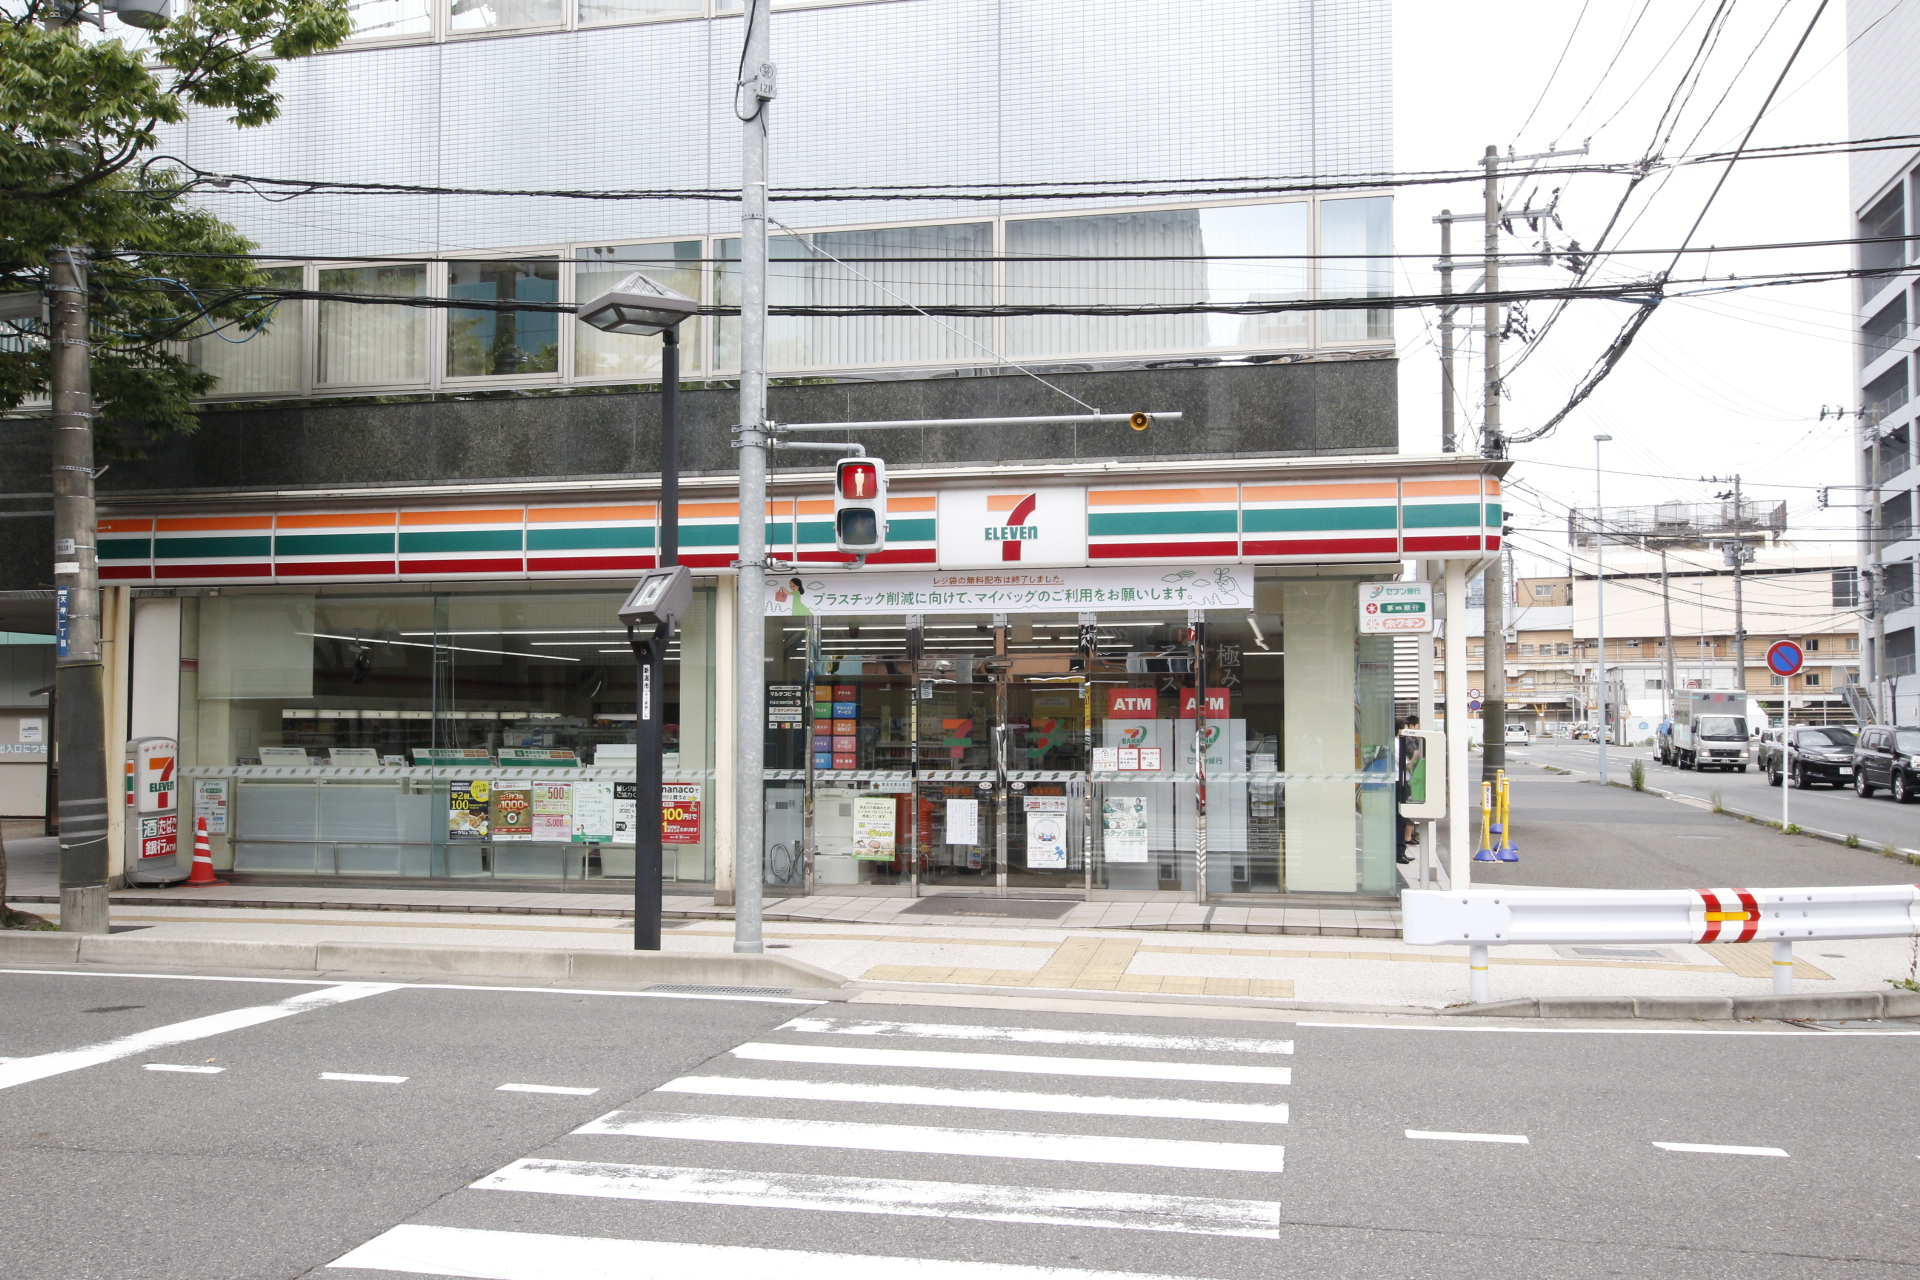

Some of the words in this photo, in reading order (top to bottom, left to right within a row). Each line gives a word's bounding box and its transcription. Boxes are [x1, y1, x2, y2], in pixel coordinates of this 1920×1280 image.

[987, 493, 1036, 561] 7
[933, 575, 1065, 585] レジ袋の無料配布は終了しました。
[813, 587, 1193, 606] プラスチック削減に向けて、マイバッグのご利用をお願いします。
[1386, 588, 1421, 596] セブン銀行
[59, 596, 67, 647] 天神一丁目
[1385, 619, 1424, 628] ホクギン
[1216, 644, 1241, 688] 極み
[1113, 697, 1152, 711] ATM
[1186, 697, 1224, 711] AM
[149, 756, 174, 808] 7
[548, 787, 564, 800] 500
[451, 800, 469, 810] 100
[143, 820, 157, 838] 酒
